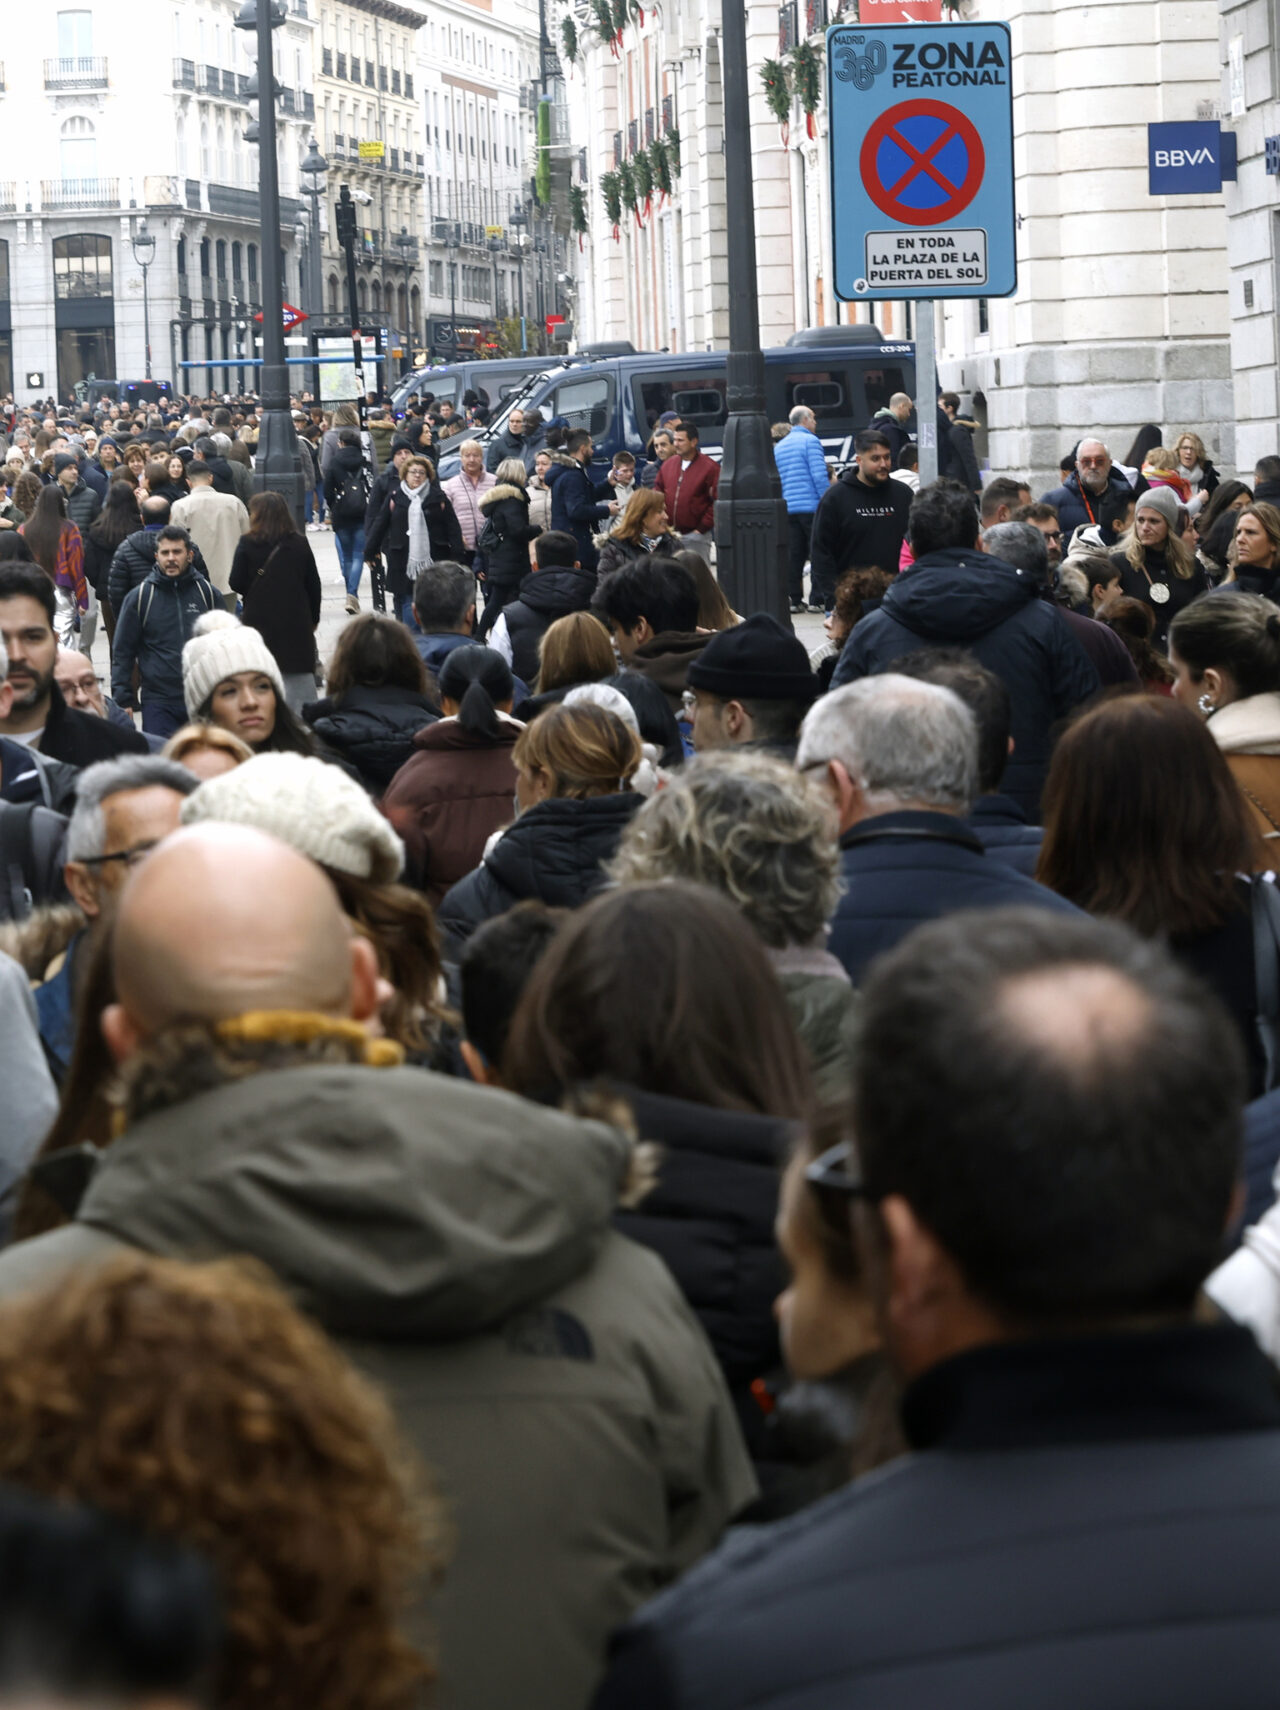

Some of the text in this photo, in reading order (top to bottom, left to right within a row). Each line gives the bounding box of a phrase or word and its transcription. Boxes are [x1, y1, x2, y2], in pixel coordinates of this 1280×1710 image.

[834, 35, 866, 46] MADRID
[893, 41, 1005, 71] ZONA
[893, 70, 1006, 88] PEATONAL
[1155, 147, 1215, 167] BBVA
[896, 237, 955, 249] EN TODA
[873, 252, 980, 265] LA PLAZA DE LA
[870, 268, 983, 281] PUERTA DEL SOL
